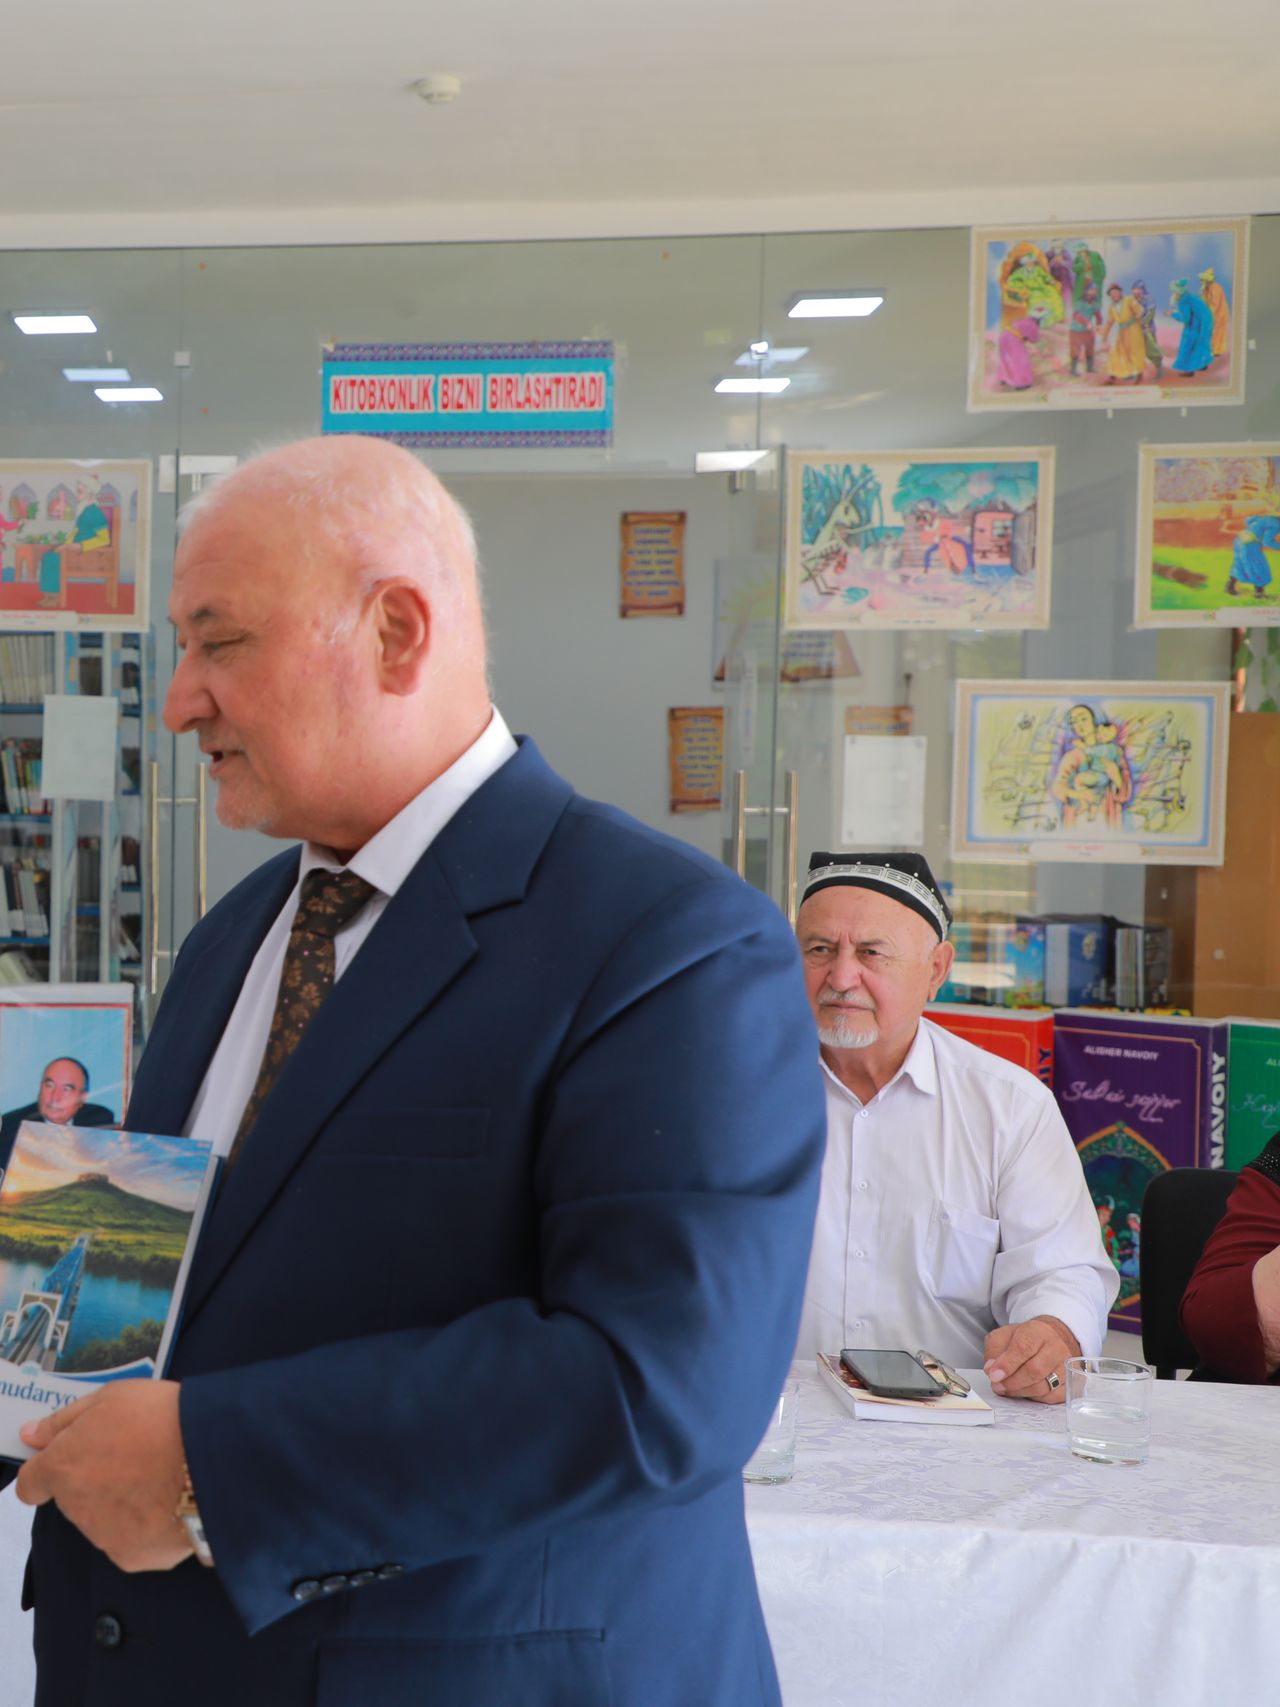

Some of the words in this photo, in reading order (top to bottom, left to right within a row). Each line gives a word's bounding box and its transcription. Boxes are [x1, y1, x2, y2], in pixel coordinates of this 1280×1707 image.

[333, 378, 433, 410] KITOBXONLIK
[440, 377, 481, 410] BIZNI
[489, 375, 604, 409] BIRLASHTIRADI
[1083, 1045, 1122, 1057] ALISHER
[1122, 1048, 1159, 1061] NAVOIY
[1210, 1051, 1226, 1170] NAVOIY
